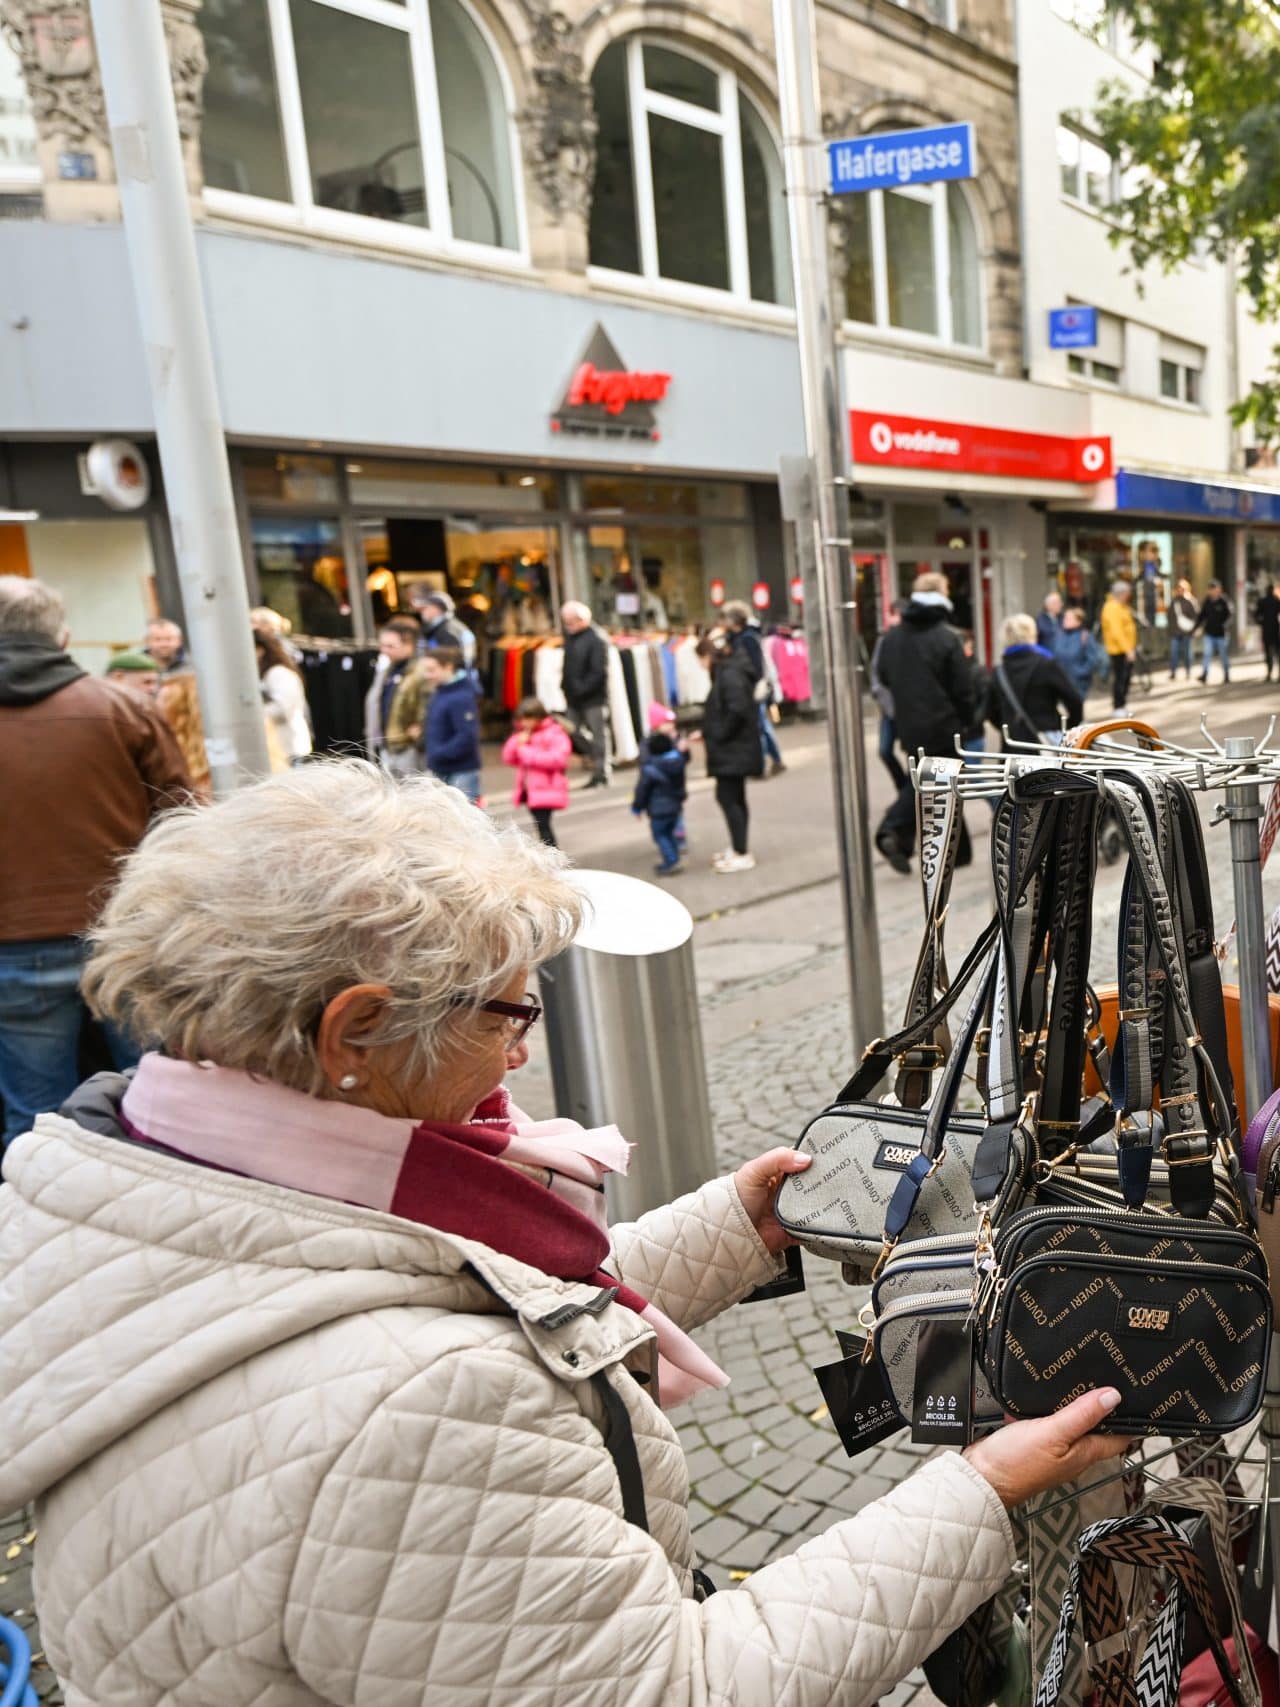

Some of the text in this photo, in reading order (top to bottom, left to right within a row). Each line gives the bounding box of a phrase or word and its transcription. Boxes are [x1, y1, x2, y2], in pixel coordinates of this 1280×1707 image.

[836, 140, 962, 183] Hafergasse
[892, 429, 960, 455] vodafone
[820, 1131, 848, 1154] COVERI
[823, 1158, 851, 1182] COVERI
[862, 1175, 880, 1203] COVERI
[941, 1189, 961, 1218] COVERI
[840, 1200, 858, 1229] COVERI
[1020, 1290, 1047, 1326] COVERI
[1048, 1278, 1104, 1328] COVERI active
[1128, 1306, 1169, 1324] COVERI
[1178, 1288, 1200, 1316] COVE
[1215, 1308, 1237, 1342] COVERI
[1042, 1329, 1099, 1380] COVERI active
[1099, 1331, 1139, 1387] COVERI active
[1140, 1338, 1195, 1386] COVERI active
[1195, 1340, 1229, 1393] COVERI active
[1023, 1360, 1040, 1381] active
[1230, 1362, 1262, 1392] COVERI
[1150, 1390, 1182, 1420] COVERI
